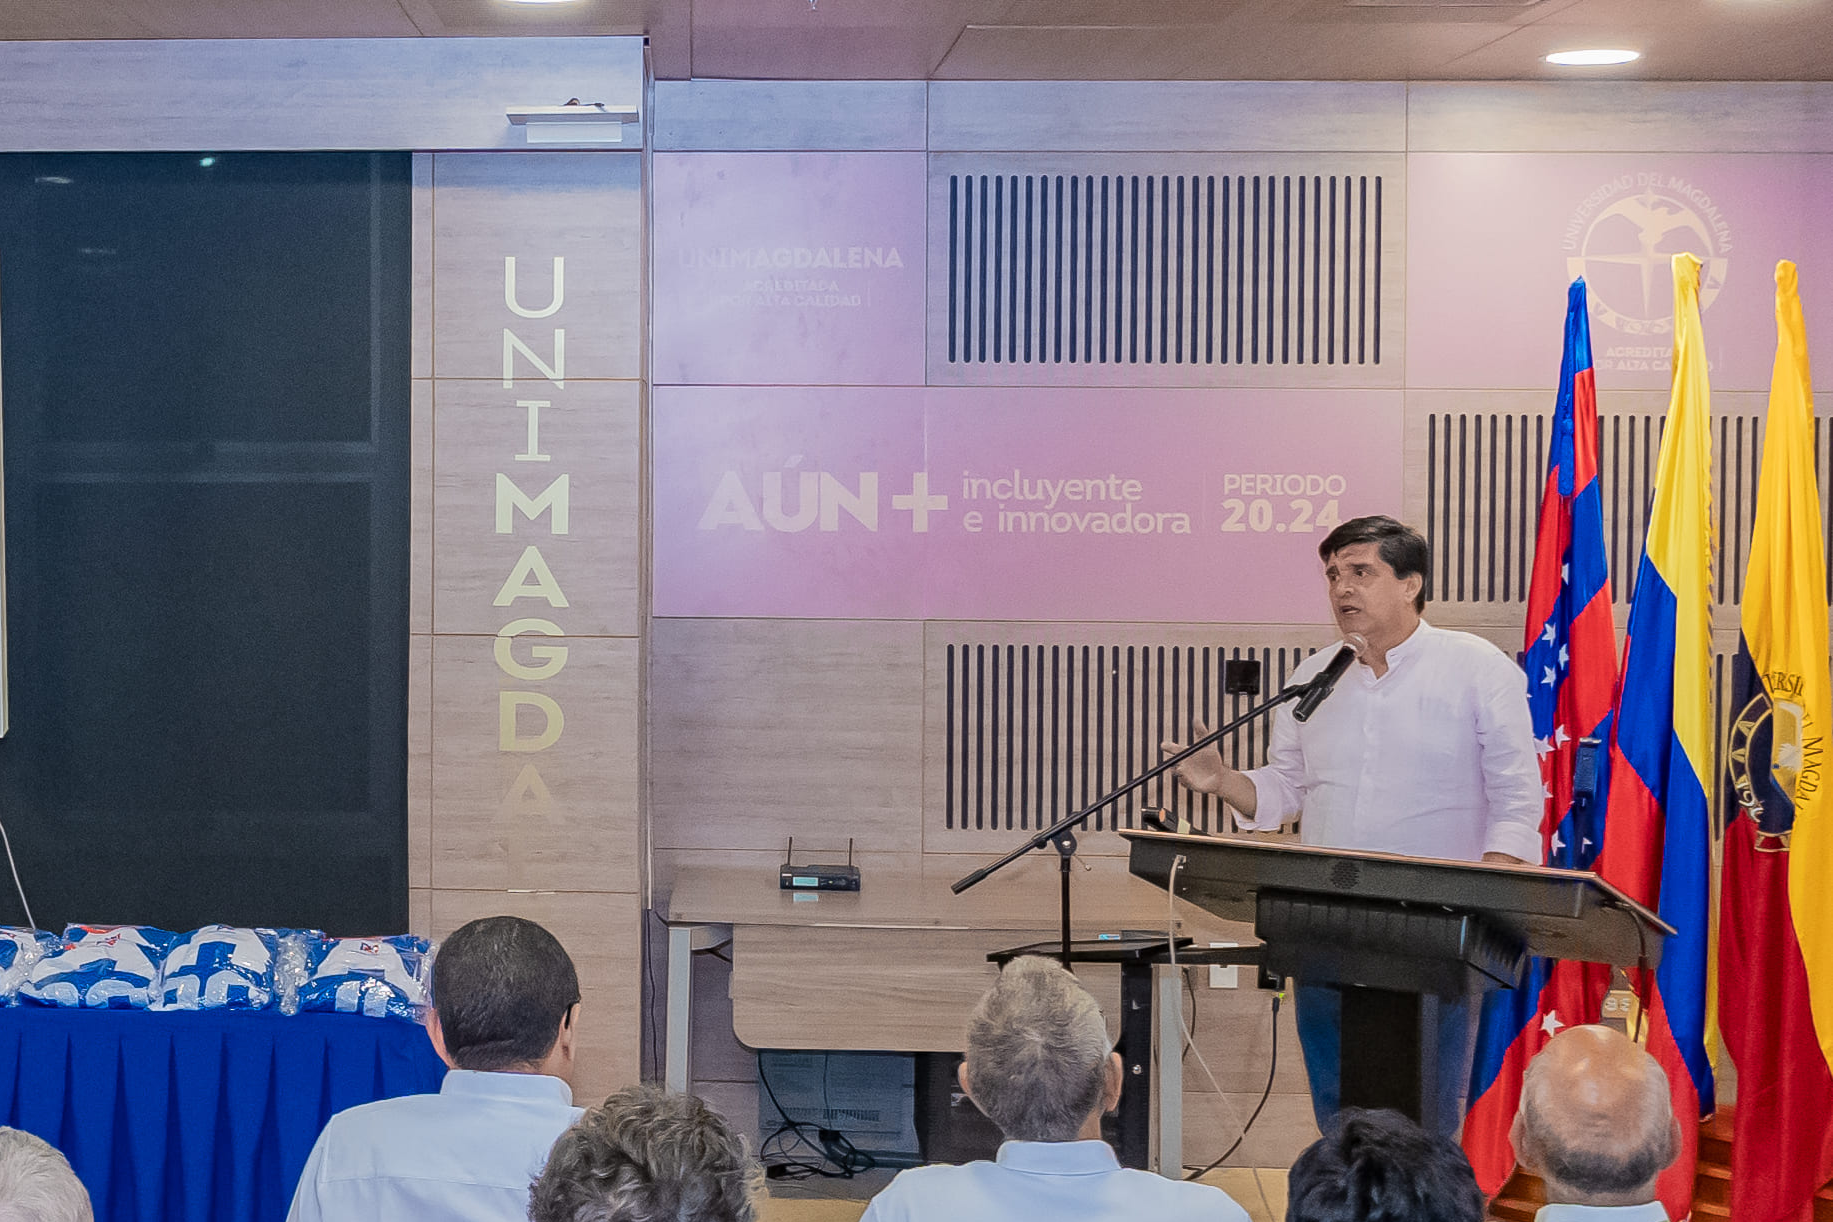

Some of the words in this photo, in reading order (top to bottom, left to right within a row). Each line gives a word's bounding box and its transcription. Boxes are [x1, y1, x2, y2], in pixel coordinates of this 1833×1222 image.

[1561, 175, 1634, 251] UNIVERSIDAD
[1638, 172, 1665, 188] DEL
[1668, 175, 1734, 253] MAGDALENA
[678, 247, 904, 269] UNIMAGDALENA
[699, 454, 879, 533] AÚN
[962, 469, 1144, 508] incluyente
[1222, 473, 1347, 496] PERIODO
[963, 510, 984, 533] e
[998, 504, 1191, 535] innovadora
[1220, 498, 1343, 533] 20.24
